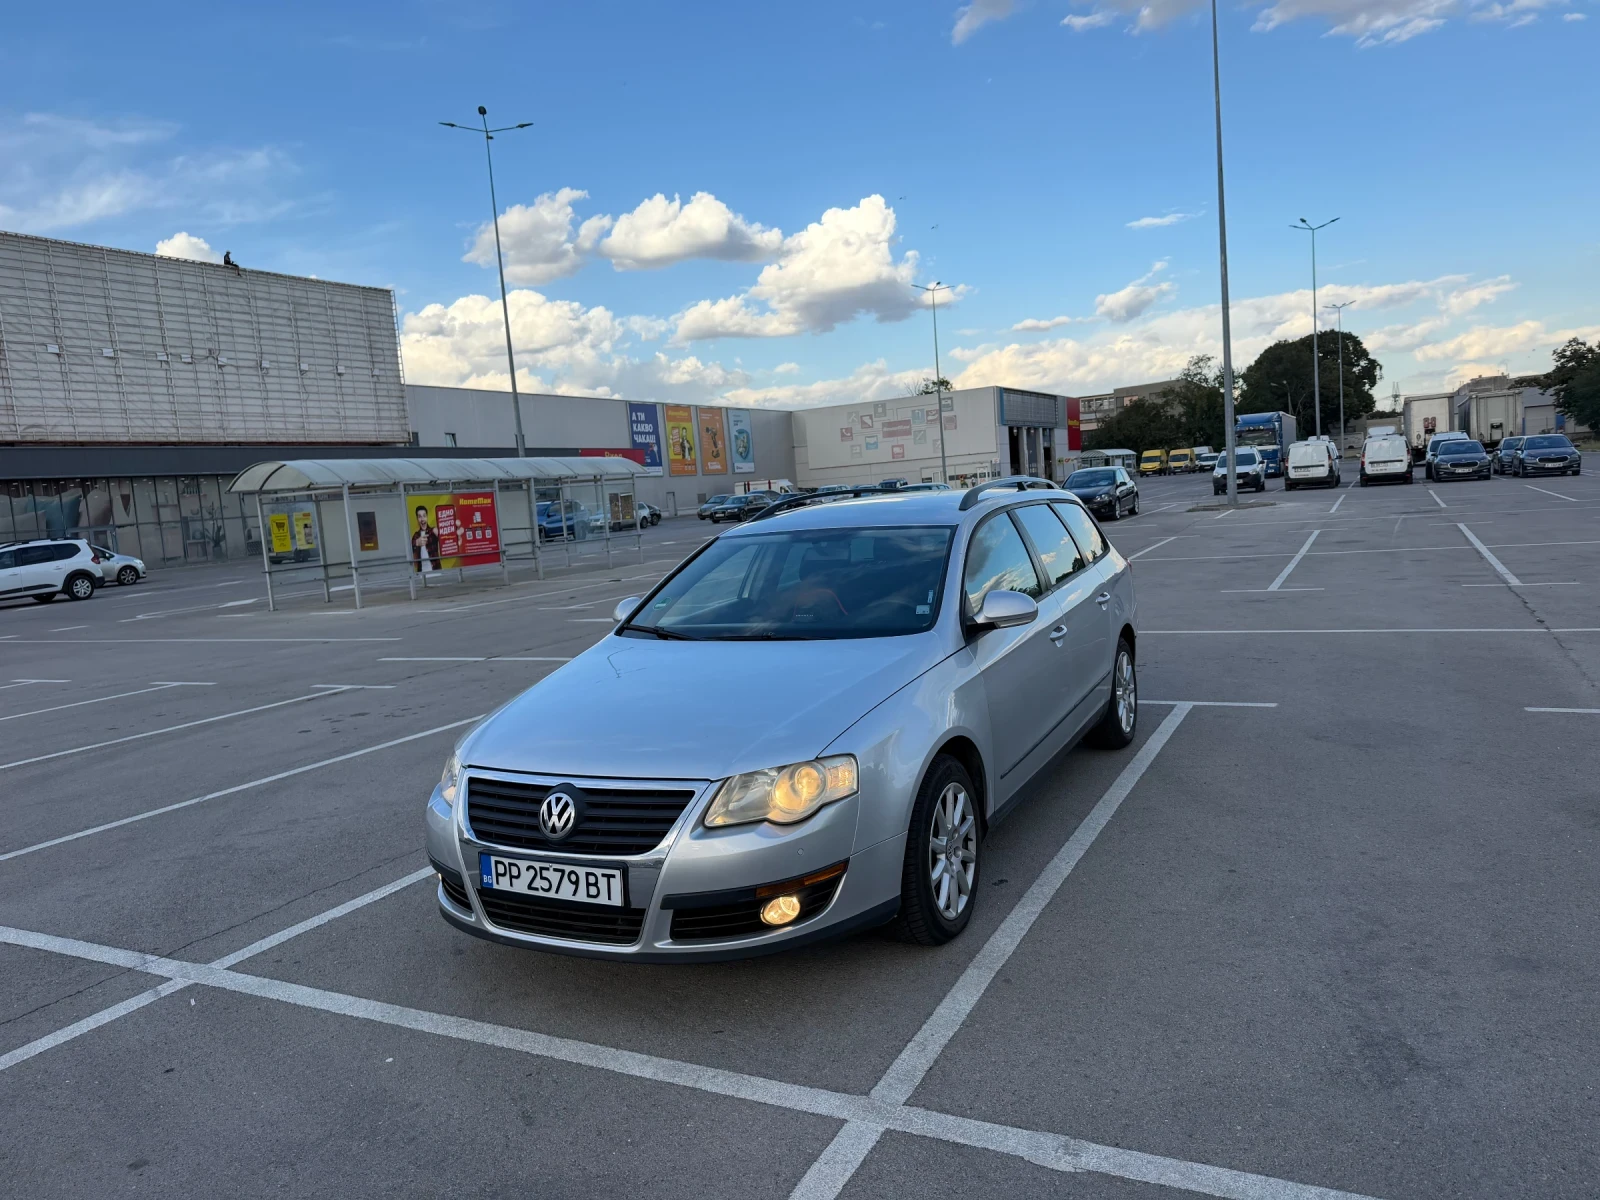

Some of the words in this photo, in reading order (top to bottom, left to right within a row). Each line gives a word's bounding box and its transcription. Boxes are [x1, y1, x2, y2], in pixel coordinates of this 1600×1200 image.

[632, 412, 636, 421] А
[637, 412, 645, 421] ТИ
[633, 423, 653, 432] КАКВО
[438, 509, 454, 518] ЕДНО
[483, 875, 492, 884] BG
[494, 859, 521, 887] PP
[525, 865, 580, 897] 2579
[585, 871, 616, 901] BT
